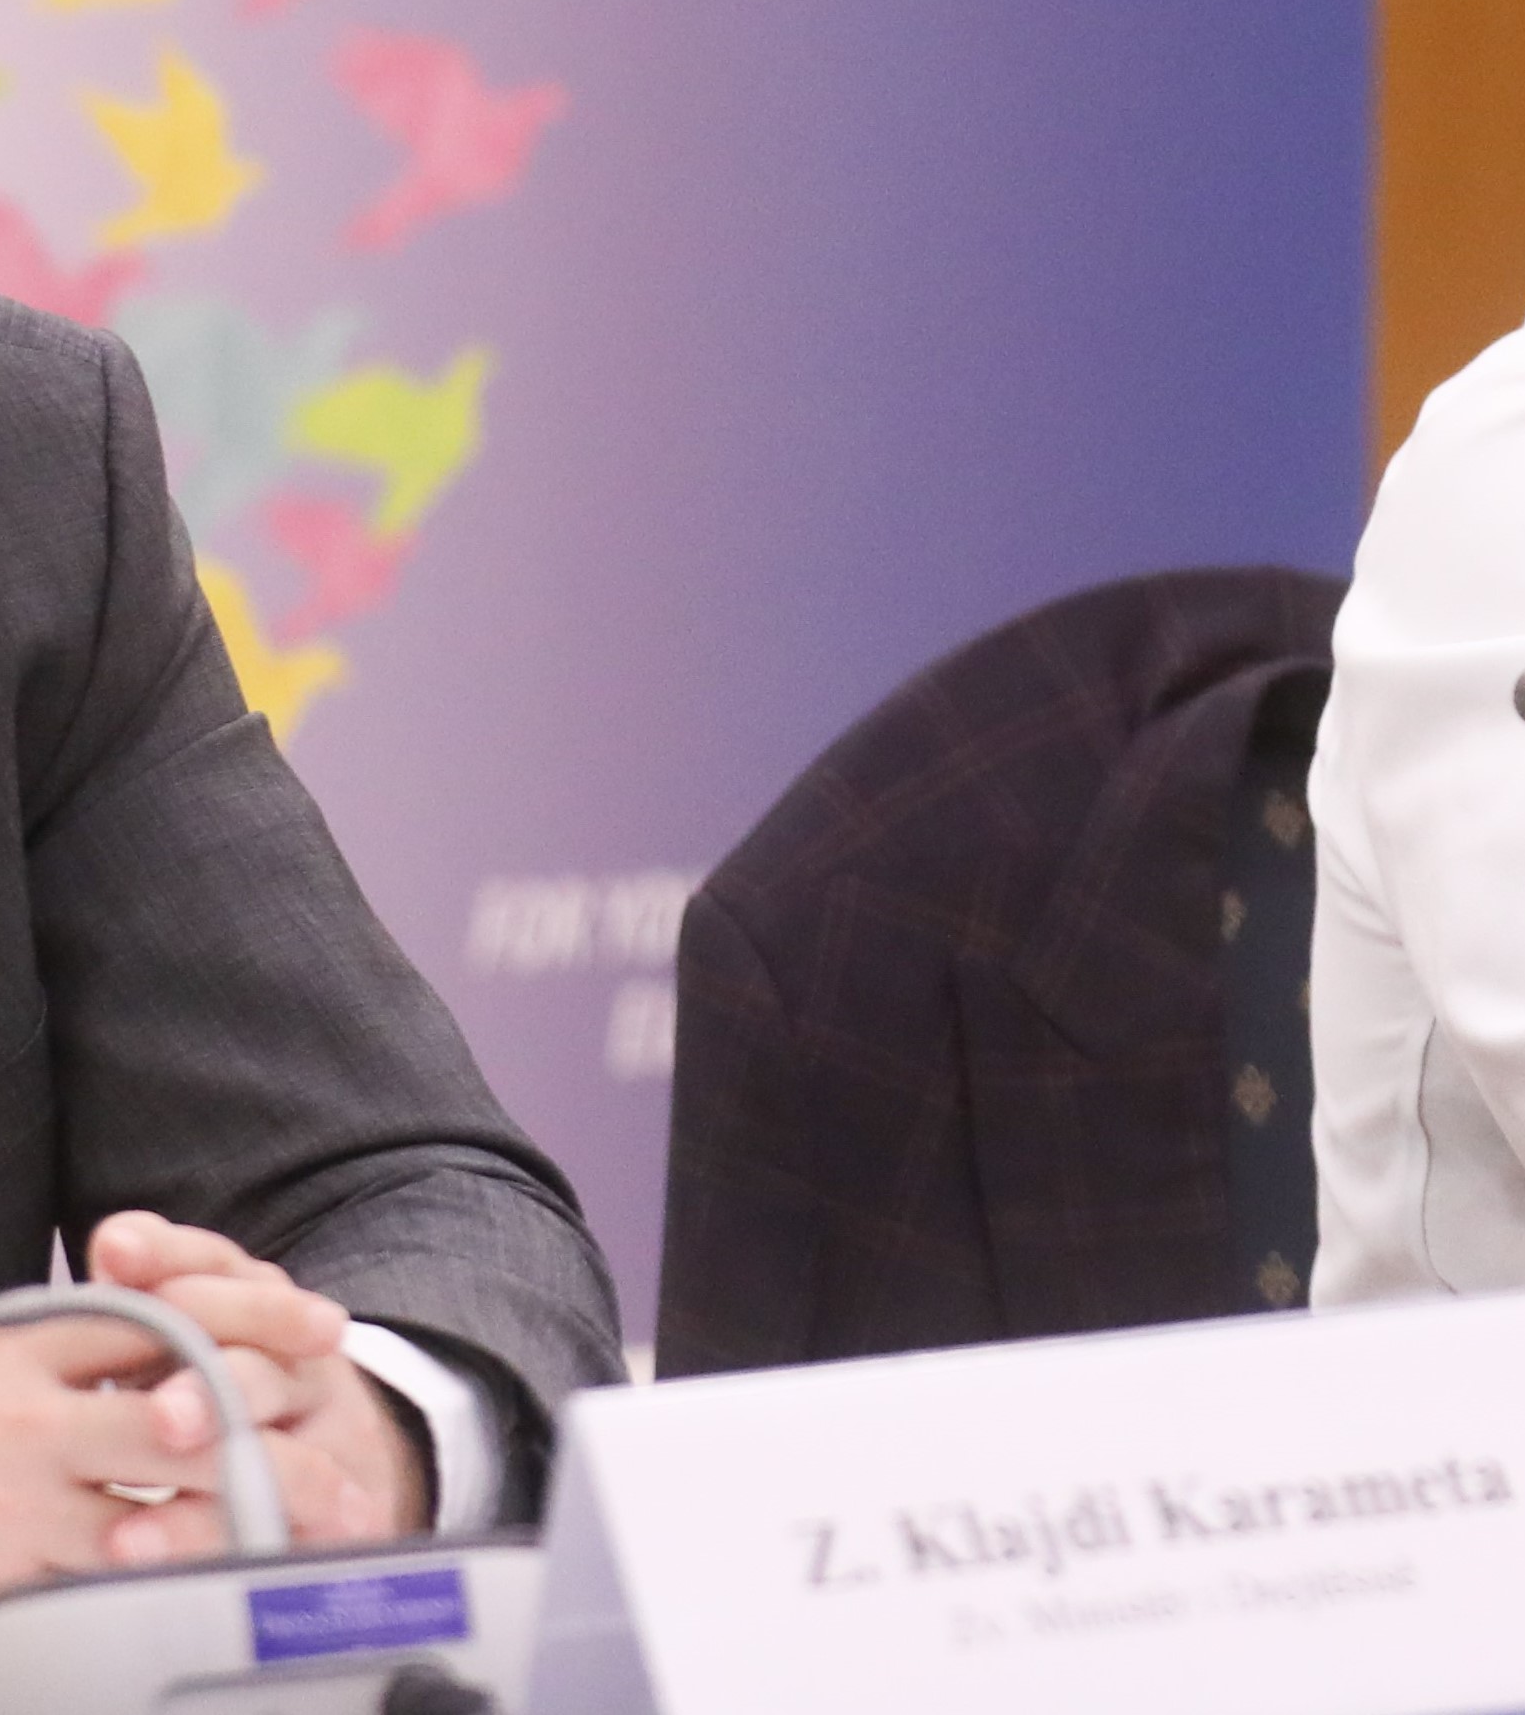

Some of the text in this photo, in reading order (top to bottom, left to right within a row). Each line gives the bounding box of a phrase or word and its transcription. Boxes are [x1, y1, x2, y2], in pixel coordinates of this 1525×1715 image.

[796, 1456, 1516, 1588] Z. Klajdi Karameta
